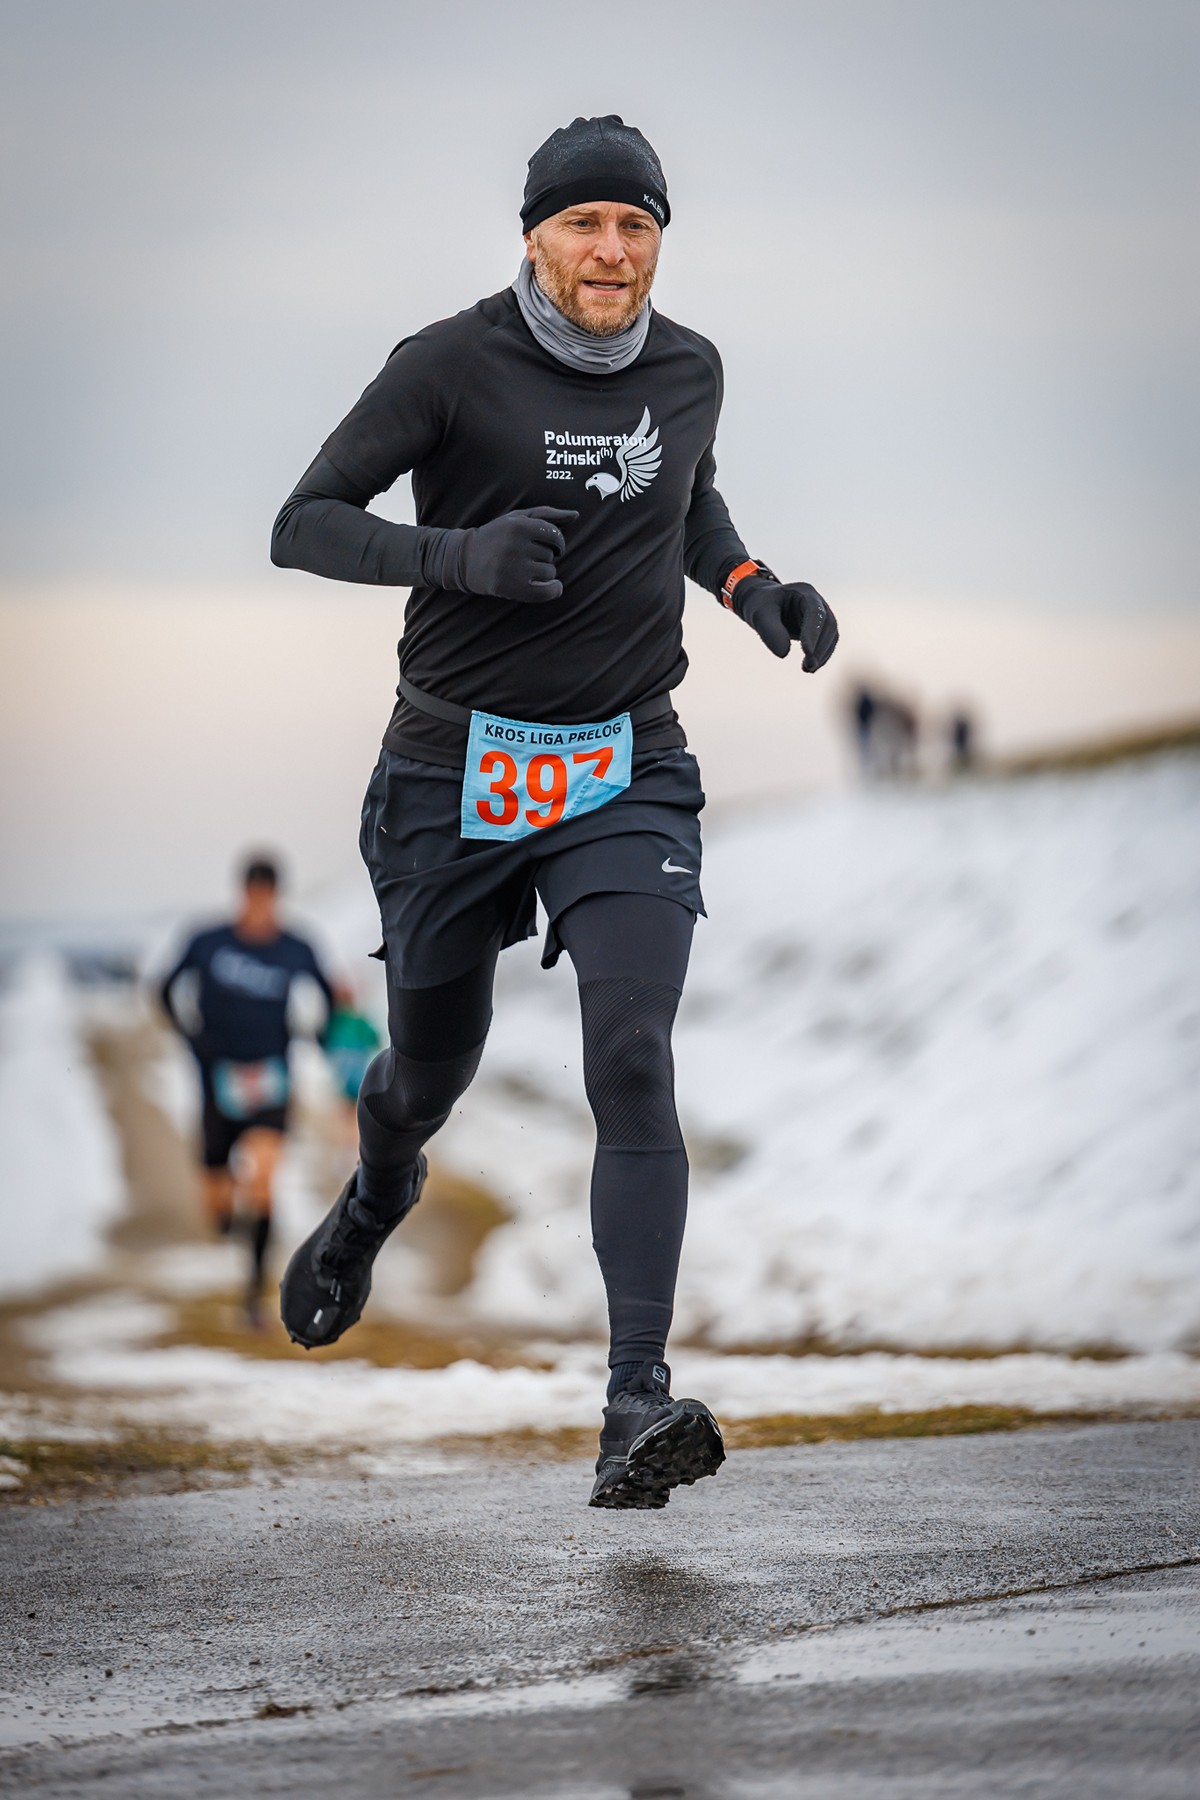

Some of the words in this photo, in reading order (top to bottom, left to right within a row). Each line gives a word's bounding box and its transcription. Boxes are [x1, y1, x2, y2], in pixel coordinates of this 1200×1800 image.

[544, 431, 647, 447] Polumaraton
[545, 470, 574, 480] 2022.
[485, 723, 525, 743] KROS
[530, 732, 564, 745] LIGA
[568, 722, 622, 743] PRELOG
[476, 746, 614, 828] 397
